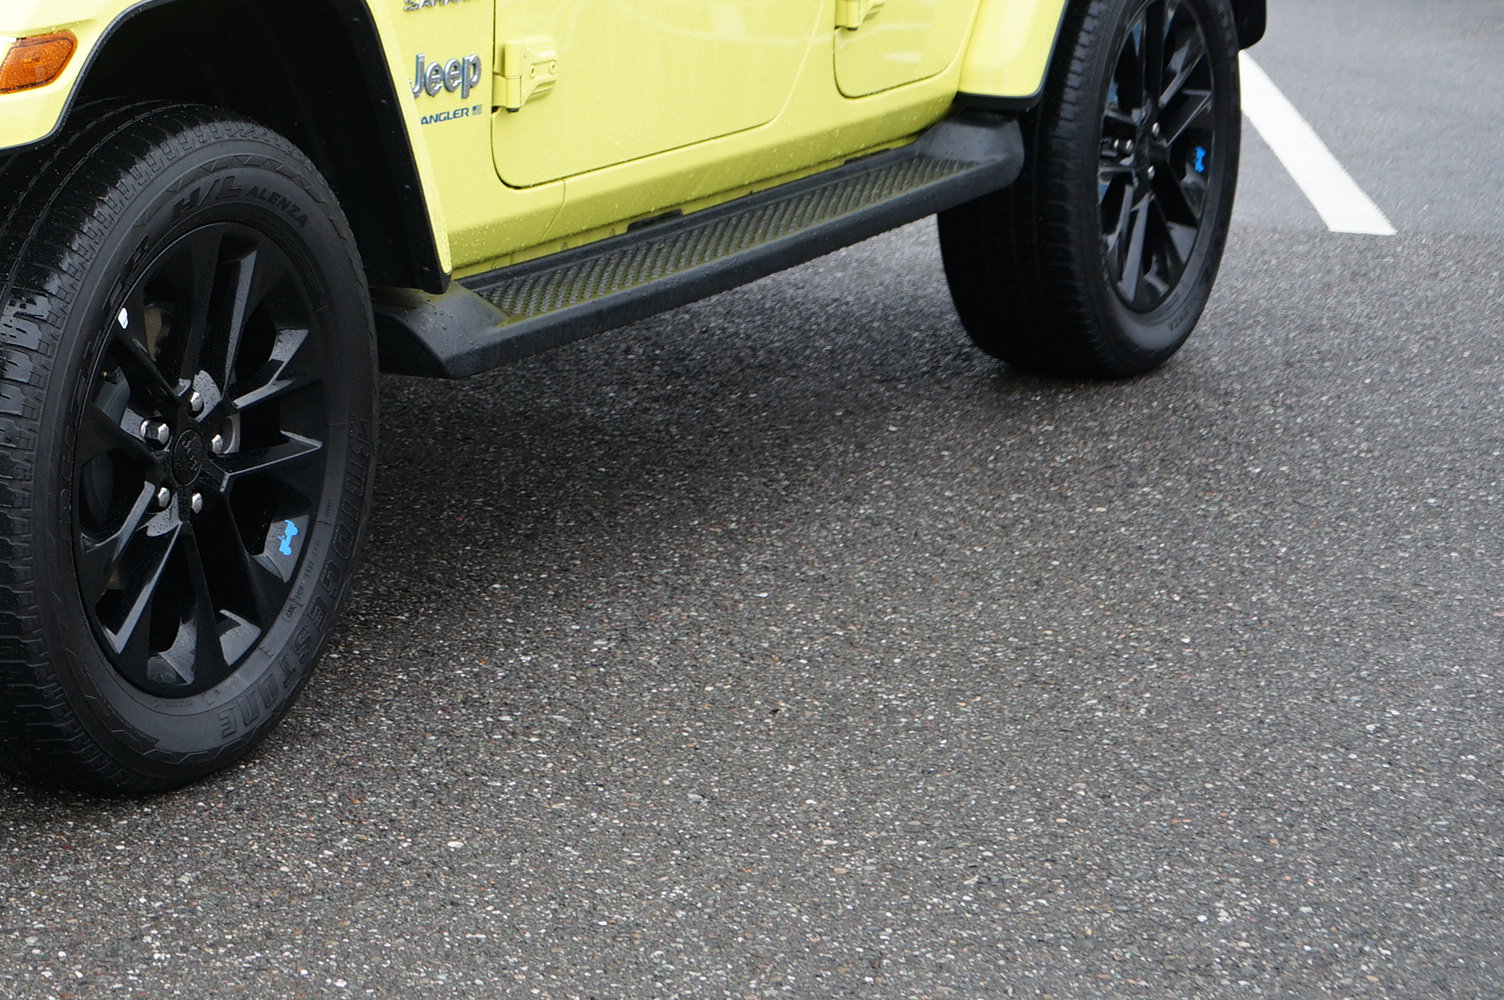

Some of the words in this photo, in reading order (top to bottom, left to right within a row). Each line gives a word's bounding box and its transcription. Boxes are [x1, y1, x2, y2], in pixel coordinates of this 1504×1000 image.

[412, 53, 482, 100] Jeep
[420, 107, 470, 125] ANGLER
[245, 185, 310, 228] ALENZA
